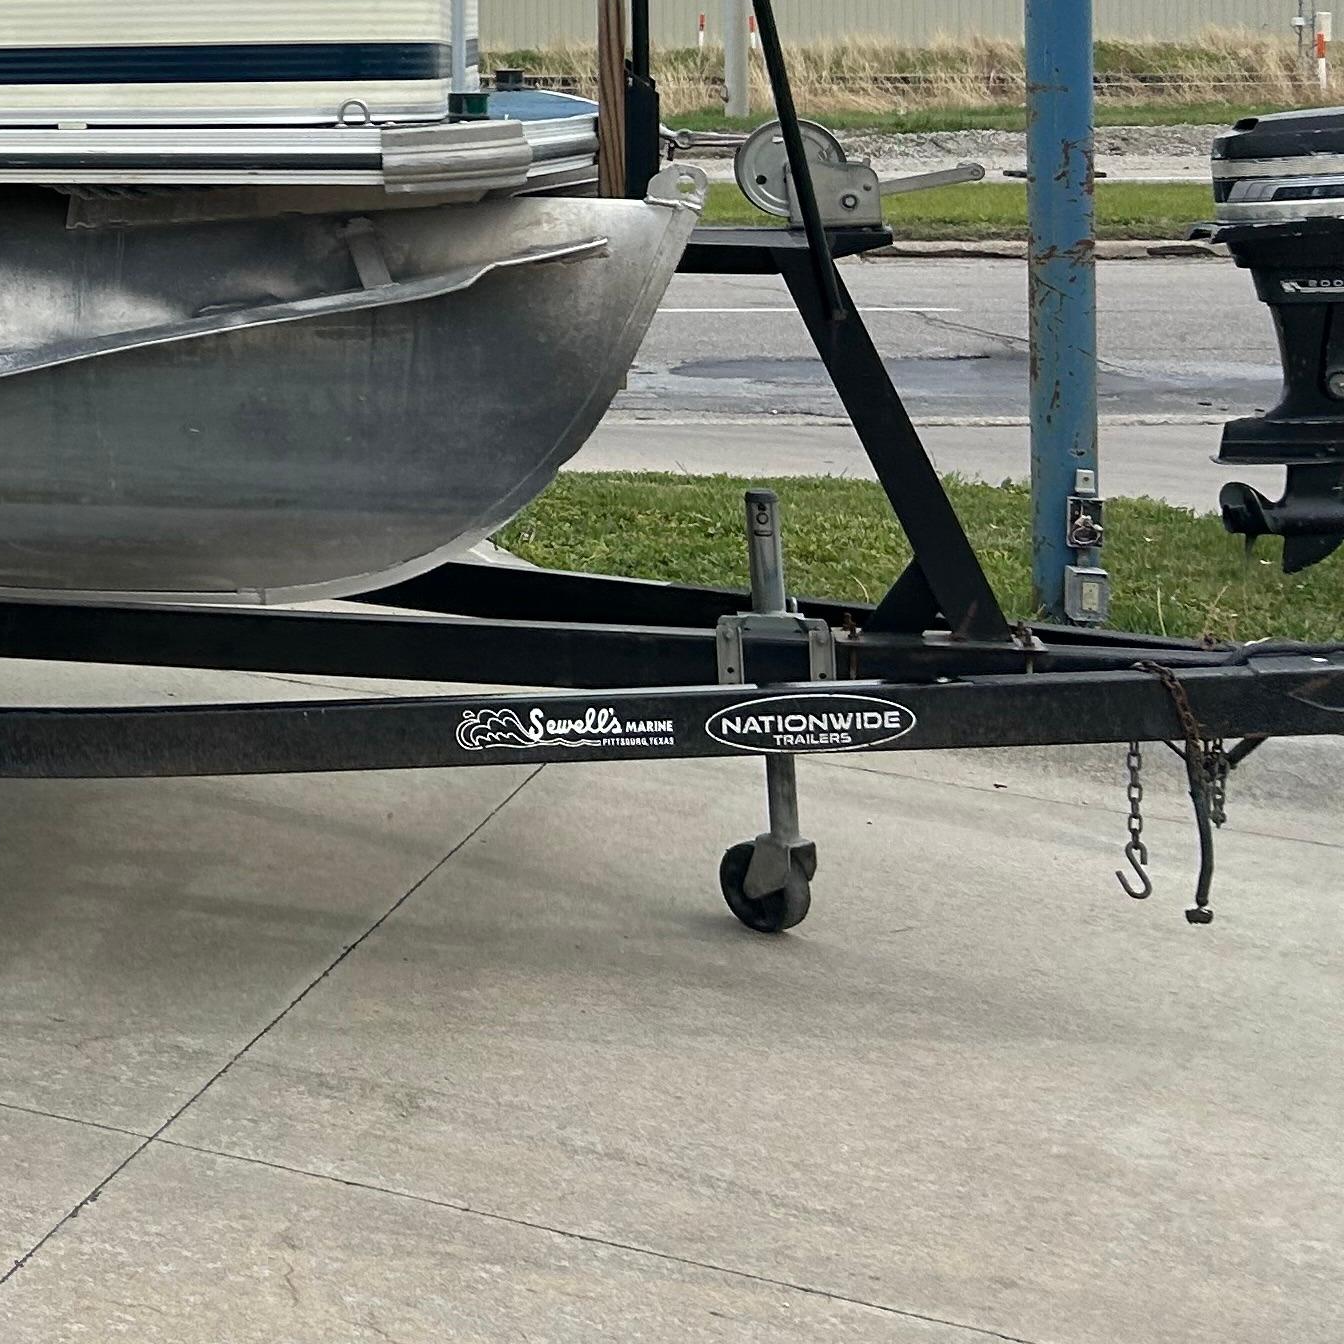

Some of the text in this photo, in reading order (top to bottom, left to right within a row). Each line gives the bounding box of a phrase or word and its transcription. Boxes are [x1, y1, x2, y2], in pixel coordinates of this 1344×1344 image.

[528, 707, 674, 741] Sewell's MARINE
[720, 710, 902, 735] NATIONWIDE
[649, 736, 675, 746] TEXAS
[771, 731, 853, 746] TRAILERS
